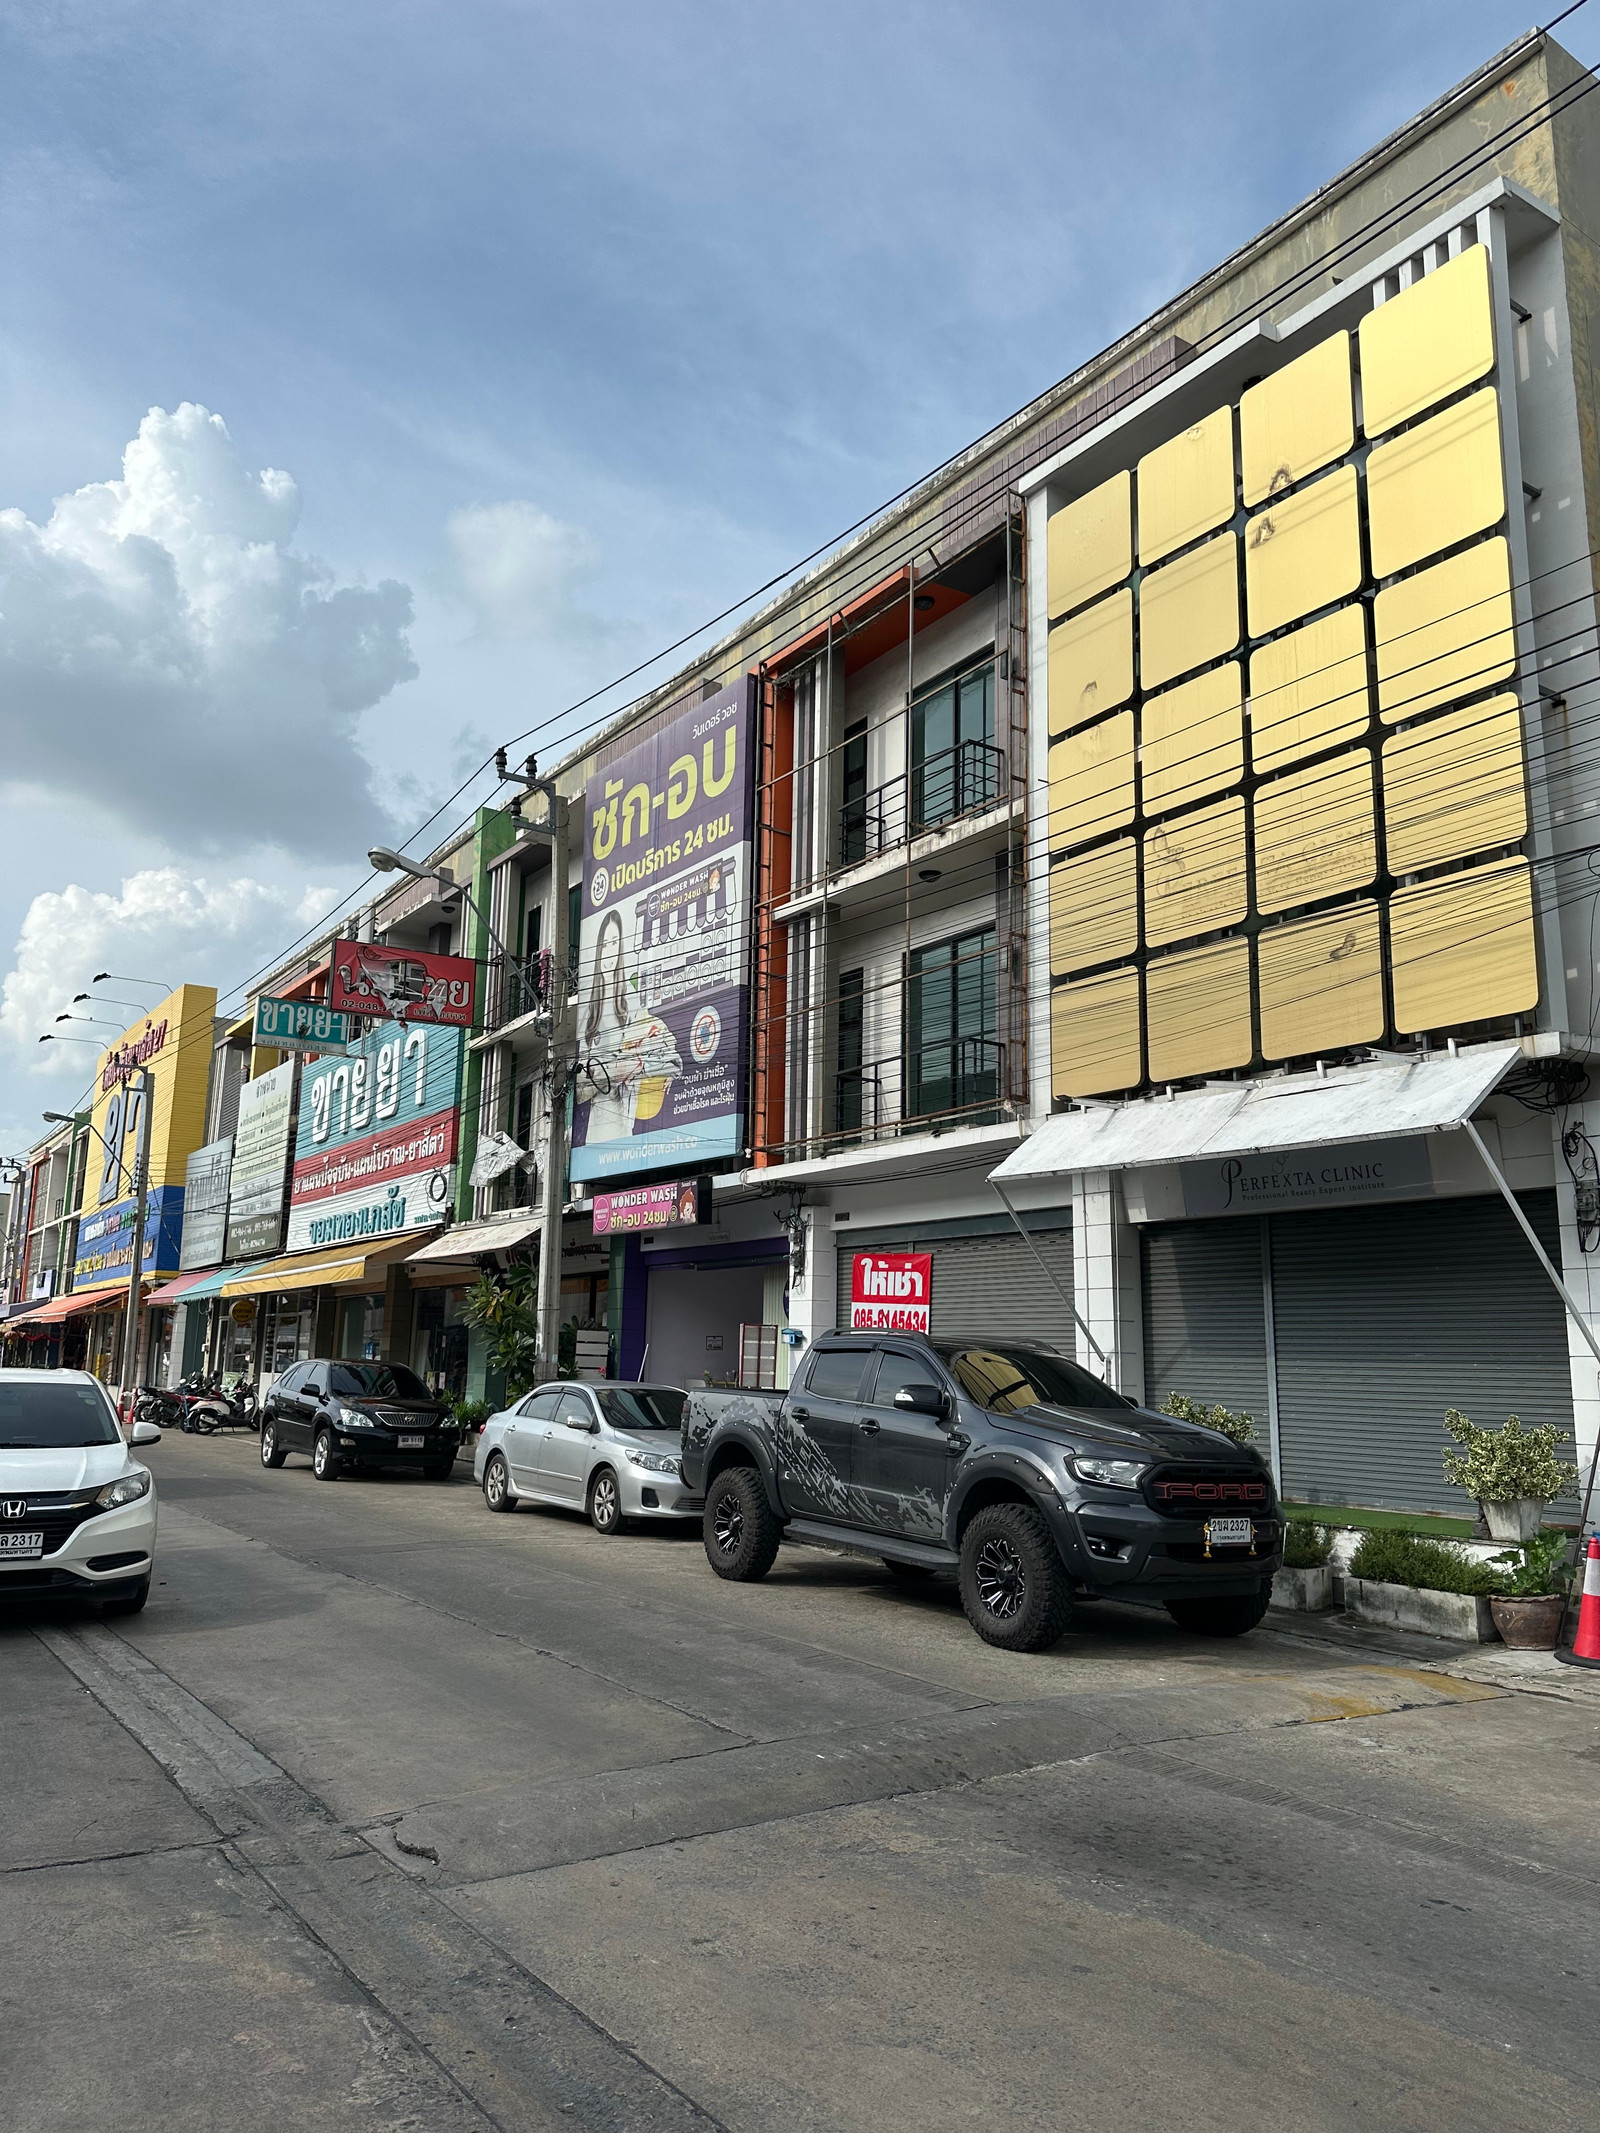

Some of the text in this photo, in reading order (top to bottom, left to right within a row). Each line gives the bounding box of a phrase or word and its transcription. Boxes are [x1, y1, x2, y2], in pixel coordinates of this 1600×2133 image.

[692, 702, 738, 740] วันเดอร์ วอช
[592, 724, 737, 861] ซัก-อบ
[611, 813, 735, 893] เปิดบริการ 24 ชม.
[661, 869, 709, 899] WONDER WASH
[660, 896, 683, 913] ซัก-อบ
[261, 1001, 347, 1042] ขายยา
[311, 1029, 430, 1144] ขายยา
[598, 1135, 698, 1165] www.wonderwash.co
[1321, 1162, 1384, 1183] CLINIC
[610, 1186, 678, 1210] WONDER WASH
[1242, 1190, 1288, 1201] Professional
[1291, 1189, 1316, 1199] Beauty
[1319, 1186, 1346, 1195] Expert
[309, 1186, 407, 1245] จอมทองเภสัช
[610, 1212, 641, 1231] ซัก-อบ
[860, 1257, 923, 1297] ให้เช่า
[1152, 1482, 1266, 1500] FORD
[11, 1533, 42, 1546] 2317
[1230, 1519, 1249, 1532] 2327
